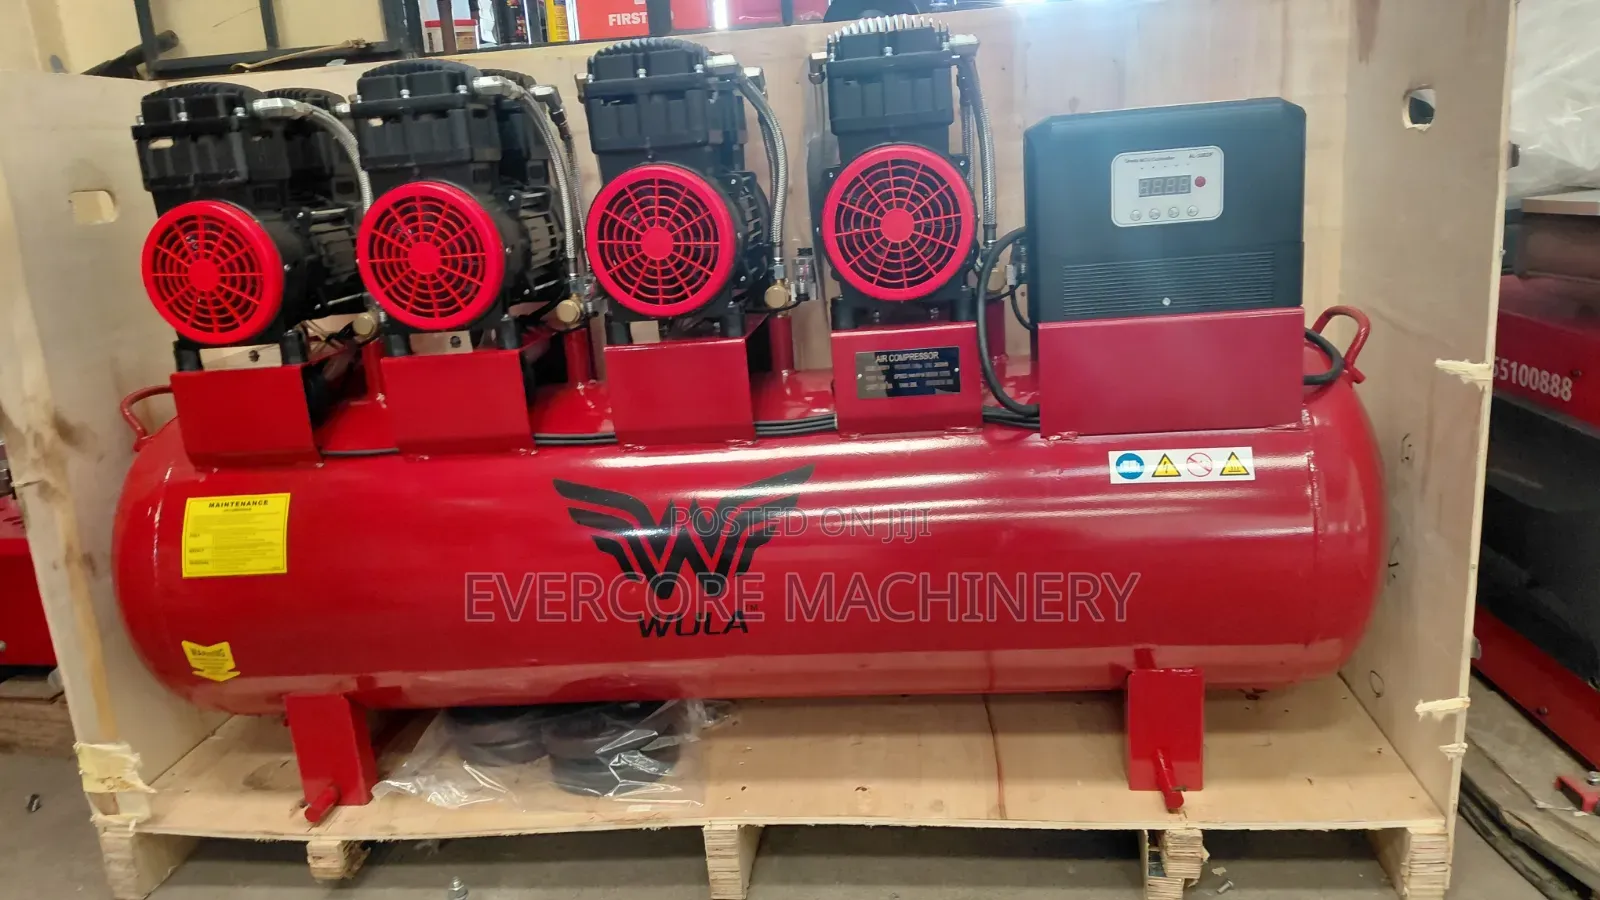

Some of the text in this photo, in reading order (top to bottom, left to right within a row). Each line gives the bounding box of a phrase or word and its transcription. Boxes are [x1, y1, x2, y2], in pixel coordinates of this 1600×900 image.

[876, 352, 939, 363] AIR COMPRESSOR
[208, 500, 268, 508] MAINTENANCE
[636, 611, 749, 638] WULA
